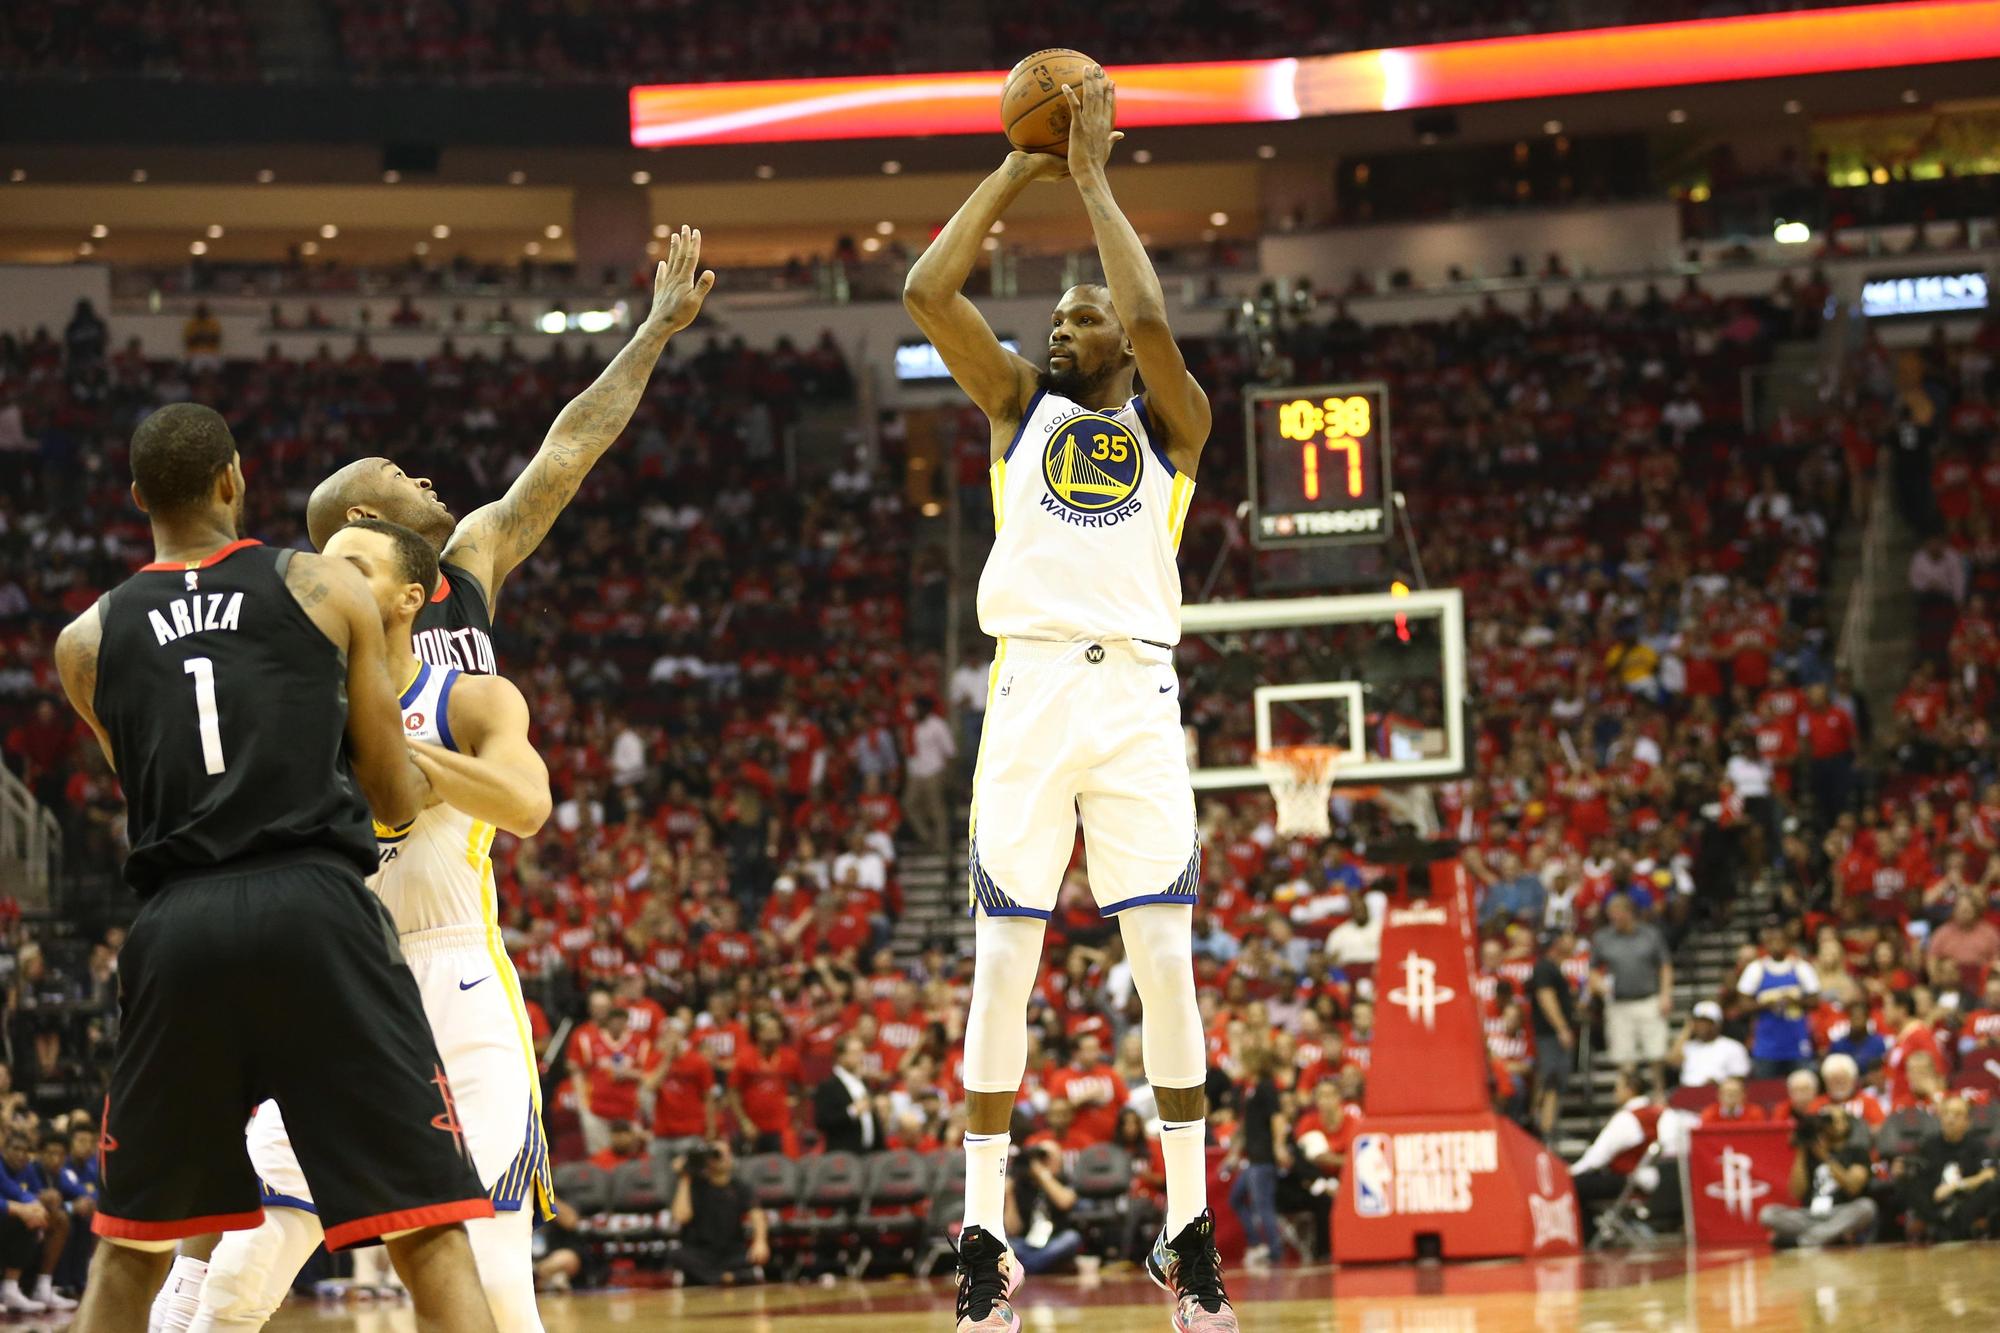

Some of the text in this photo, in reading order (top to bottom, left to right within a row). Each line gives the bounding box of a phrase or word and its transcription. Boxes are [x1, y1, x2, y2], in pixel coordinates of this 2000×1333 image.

[1280, 396, 1370, 440] 10:38
[1091, 433, 1128, 462] 35
[1304, 435, 1363, 499] 17
[1040, 492, 1142, 527] WARRIORS
[1294, 508, 1383, 535] TISSOT
[148, 592, 244, 646] ARIZA
[1087, 649, 1104, 660] W
[184, 657, 226, 775] 1
[1394, 1130, 1498, 1173] WESTERN
[1396, 1169, 1473, 1214] FINALS
